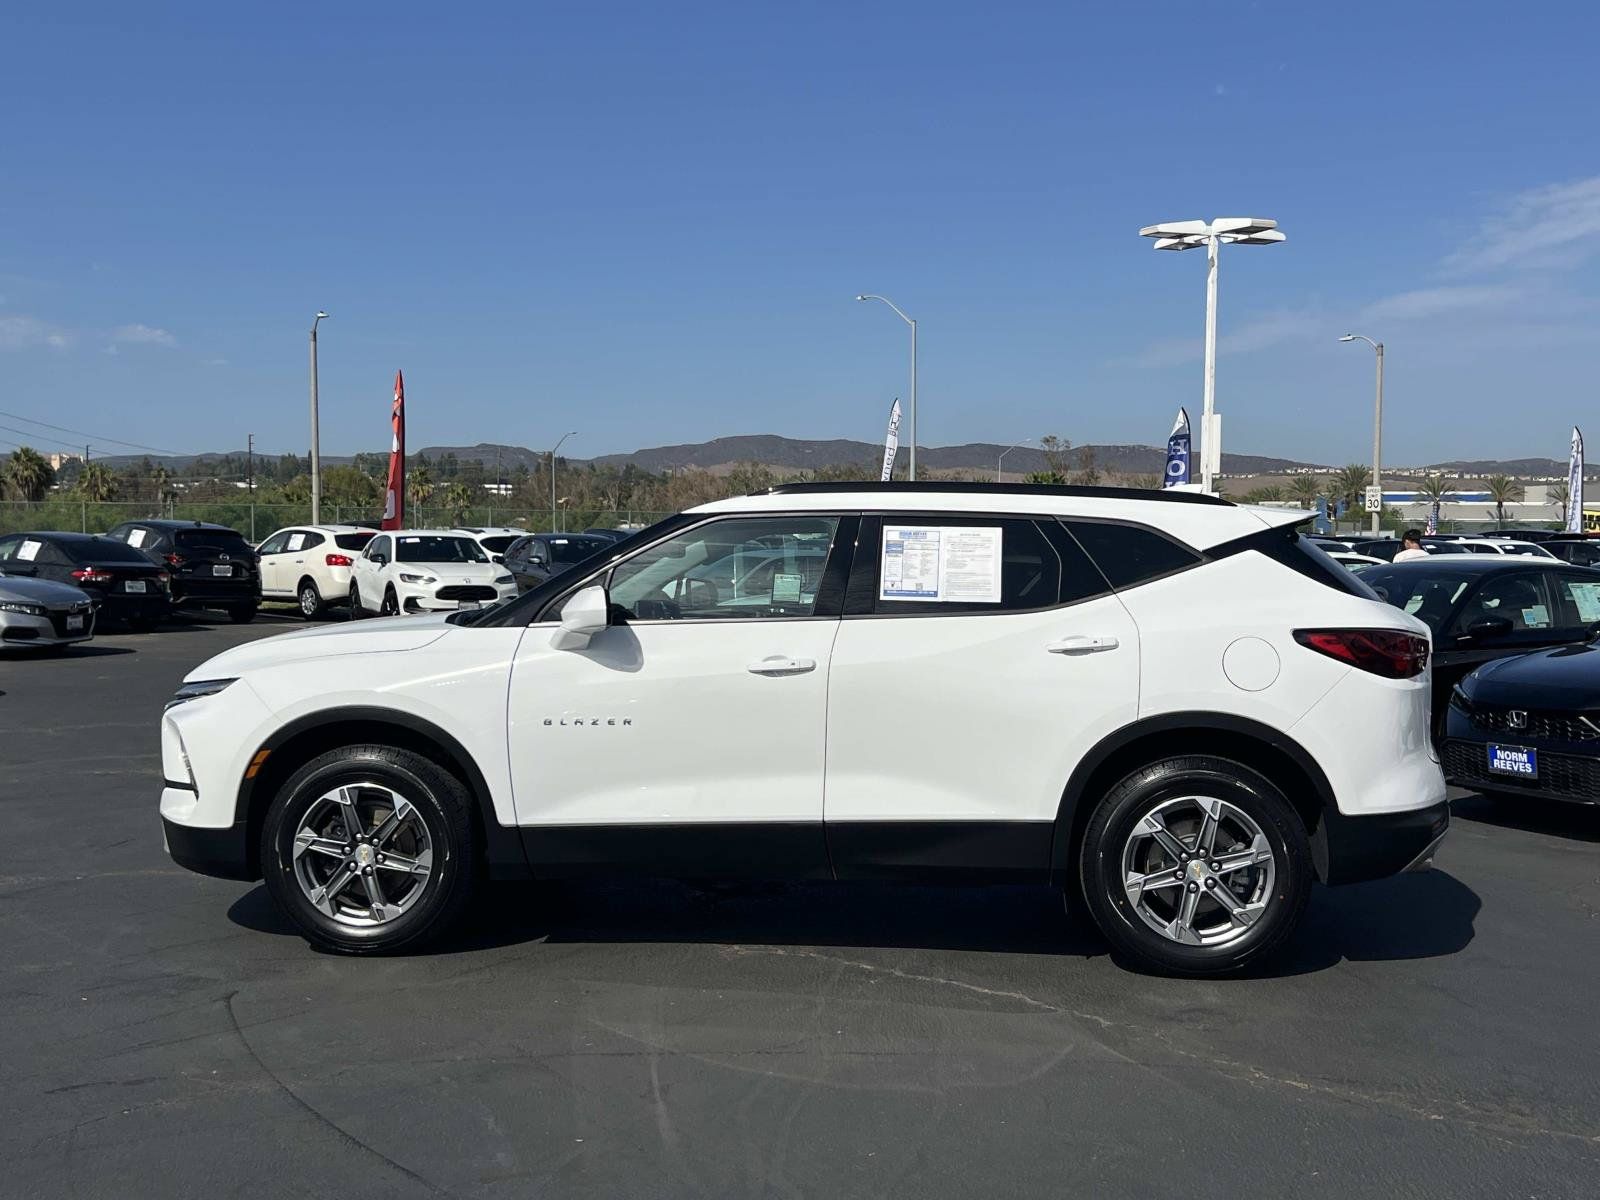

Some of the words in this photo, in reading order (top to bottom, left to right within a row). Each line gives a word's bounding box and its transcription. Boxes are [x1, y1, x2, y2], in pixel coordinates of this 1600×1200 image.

[1367, 499, 1379, 509] 30
[543, 718, 632, 726] BLAZER
[1496, 749, 1528, 763] NORM
[1493, 759, 1533, 773] REEVES
